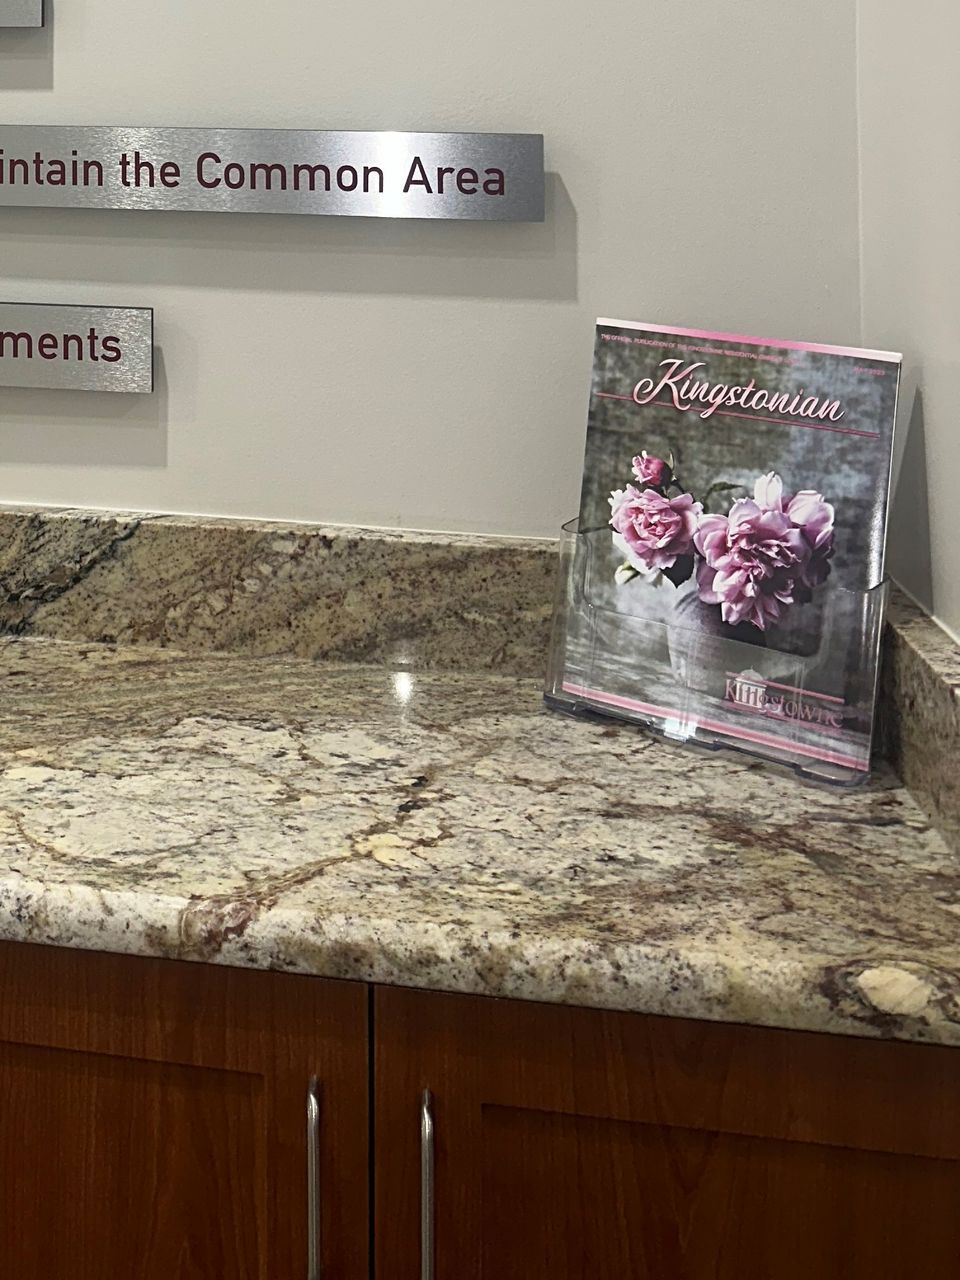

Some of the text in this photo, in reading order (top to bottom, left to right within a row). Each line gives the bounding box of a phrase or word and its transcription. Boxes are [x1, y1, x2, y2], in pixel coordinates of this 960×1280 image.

[119, 151, 181, 189] the
[196, 152, 385, 193] Common
[402, 156, 507, 197] Area
[632, 358, 845, 422] Kingstonian
